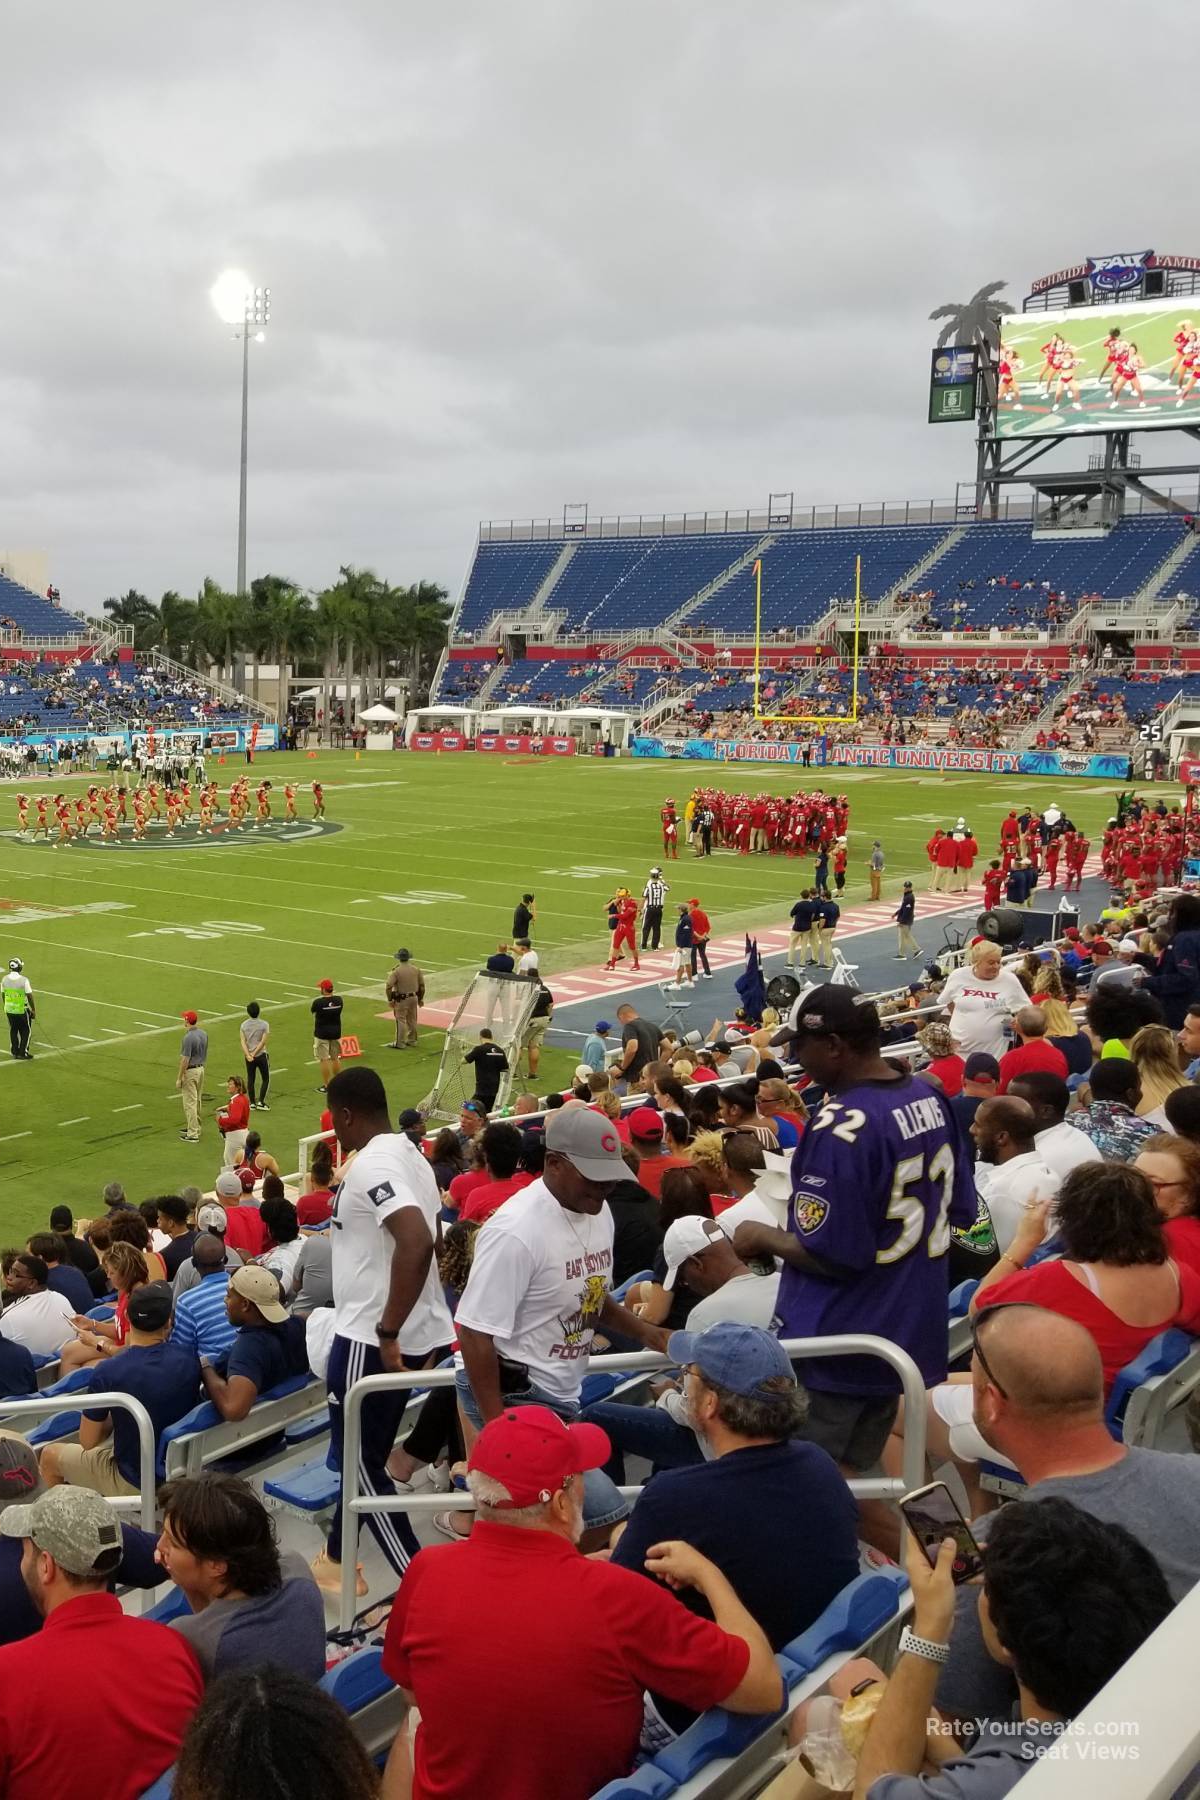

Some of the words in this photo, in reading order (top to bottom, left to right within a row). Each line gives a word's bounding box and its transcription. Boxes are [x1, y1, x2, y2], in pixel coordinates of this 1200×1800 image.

[1091, 252, 1146, 274] FAU
[1032, 264, 1088, 292] SCHMIDT
[1139, 725, 1161, 741] 25
[715, 742, 790, 761] FLORIDA
[896, 749, 1023, 772] UNIVERSITY
[378, 889, 468, 906] 40
[155, 919, 266, 939] 30
[962, 988, 1000, 1001] FAU
[340, 1038, 358, 1055] 20
[811, 1102, 867, 1144] 52
[874, 1142, 956, 1265] 52
